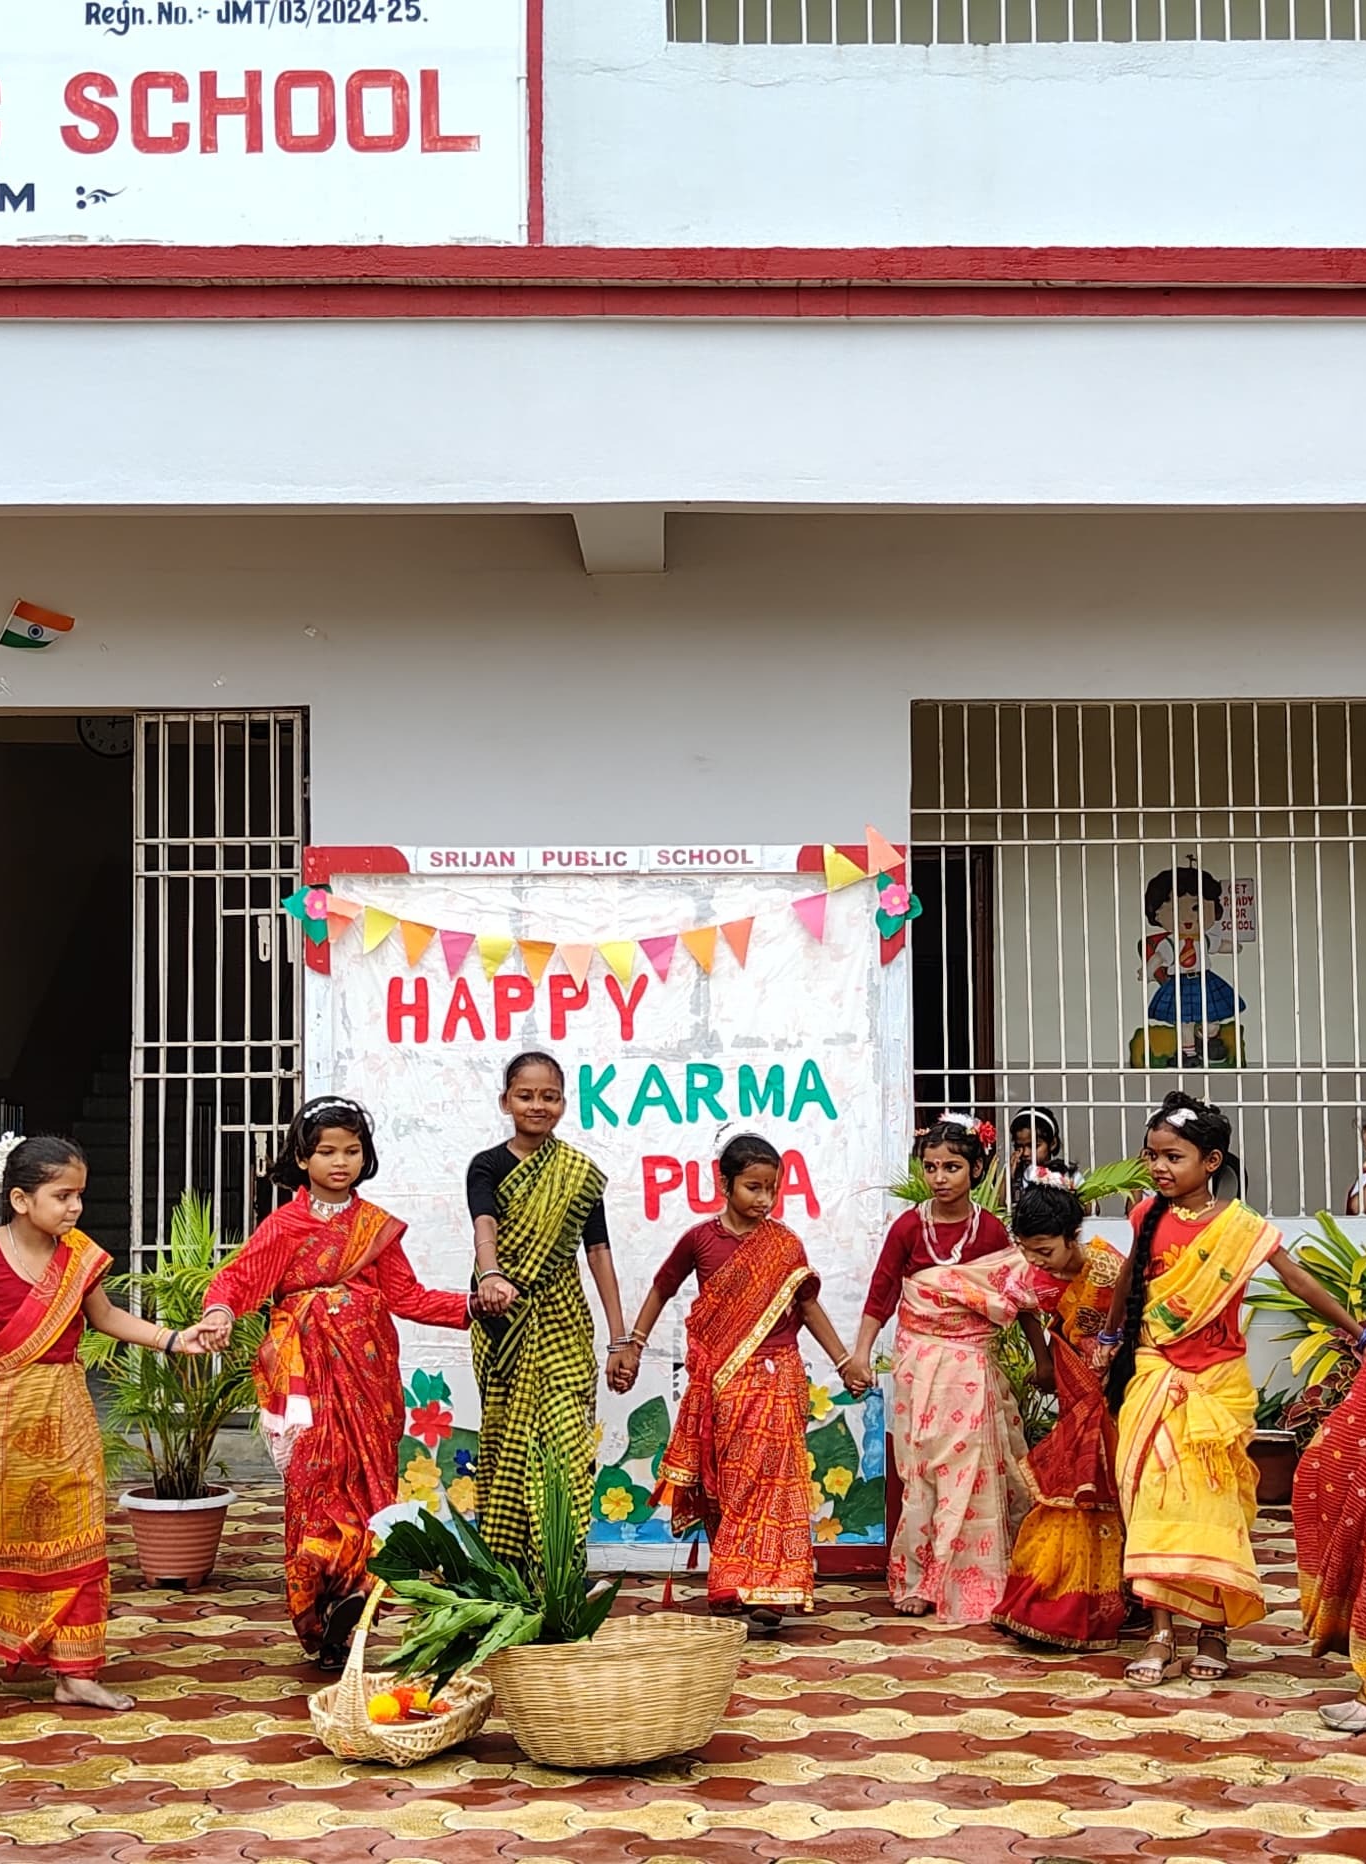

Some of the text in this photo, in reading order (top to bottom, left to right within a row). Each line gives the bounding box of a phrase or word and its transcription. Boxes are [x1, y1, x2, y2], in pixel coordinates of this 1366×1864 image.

[60, 69, 481, 154] SCHOOL
[430, 849, 754, 867] SRIJAN PUBLIC SCHOOL
[1221, 921, 1255, 931] SCOOL
[386, 974, 648, 1044] HAPPY
[579, 1058, 838, 1130] KARMA
[641, 1149, 821, 1221] PUA
